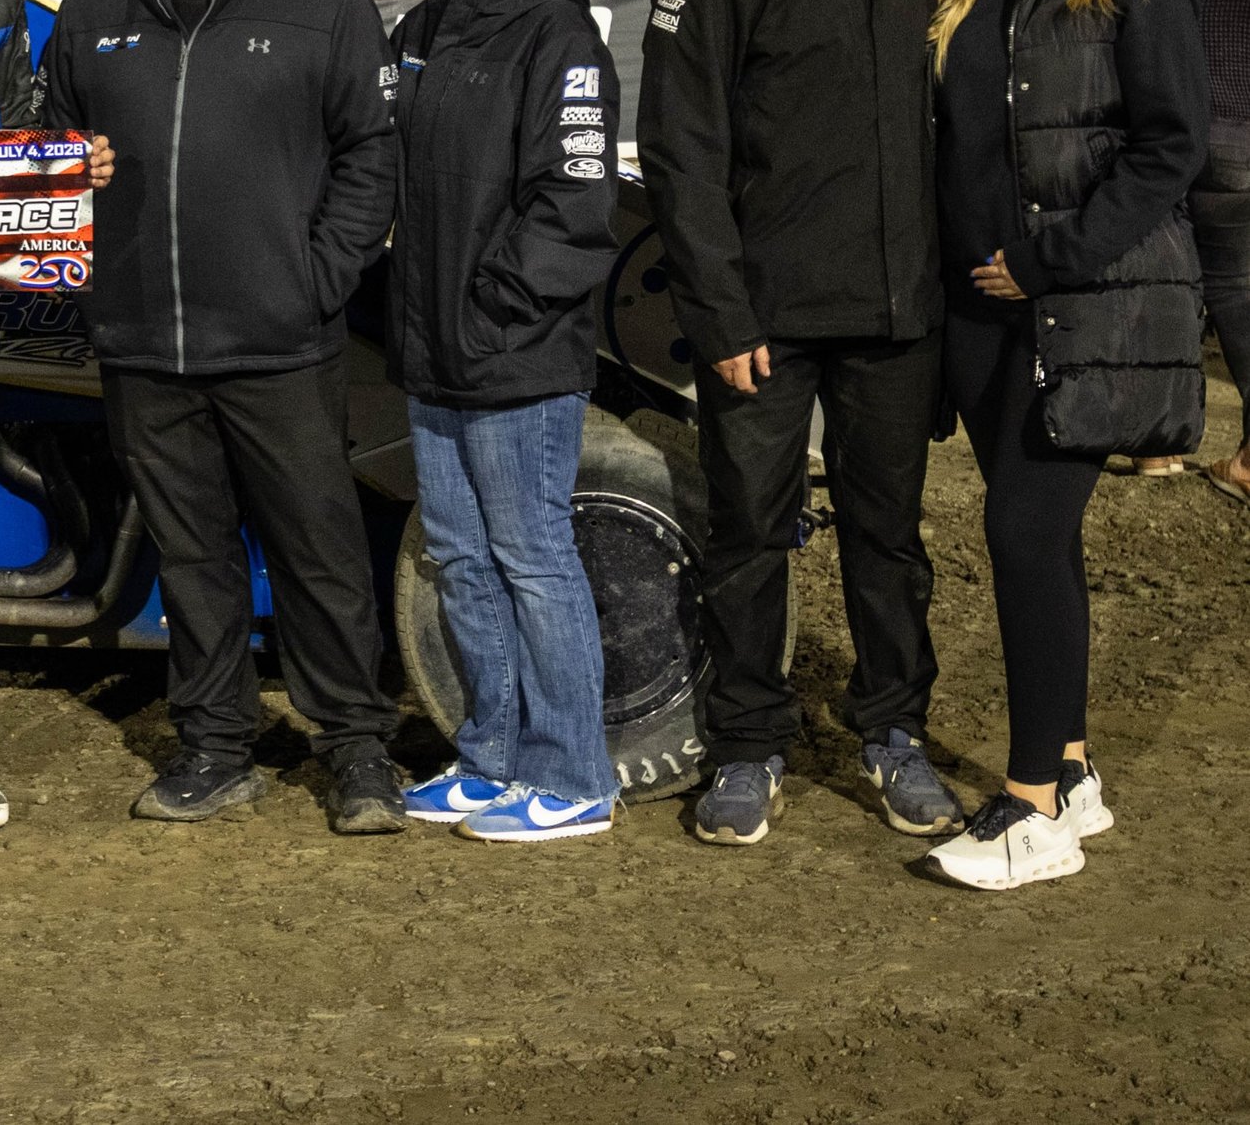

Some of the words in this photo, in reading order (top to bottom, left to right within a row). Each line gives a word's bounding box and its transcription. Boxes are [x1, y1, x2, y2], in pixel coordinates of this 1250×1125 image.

[564, 67, 600, 98] 26
[27, 145, 42, 159] 4,
[44, 142, 85, 157] 2026
[19, 239, 87, 252] AMERICA
